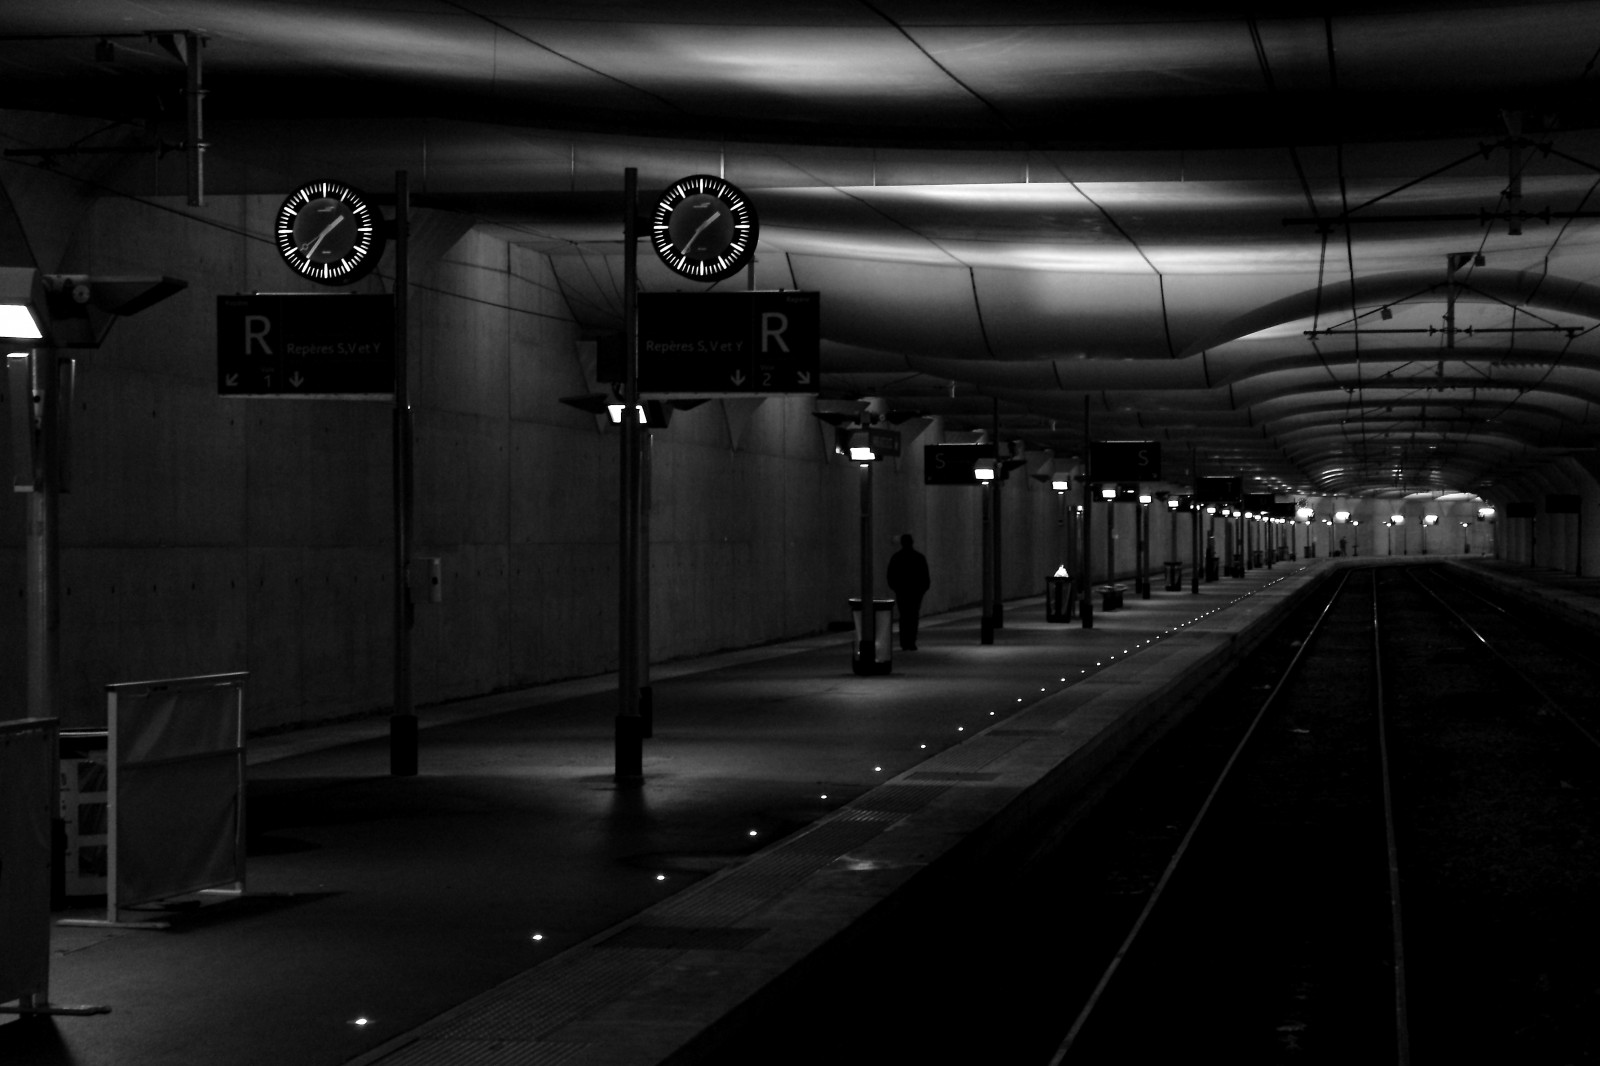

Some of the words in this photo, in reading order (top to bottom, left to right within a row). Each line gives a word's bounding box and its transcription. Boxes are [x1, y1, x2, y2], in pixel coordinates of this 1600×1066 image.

[244, 314, 274, 356] R
[761, 311, 791, 354] R
[286, 341, 335, 358] Repères
[358, 343, 371, 355] et
[371, 342, 381, 355] Y
[645, 339, 695, 354] Repères
[720, 340, 734, 352] et
[735, 339, 744, 352] Y
[263, 374, 272, 388] 1
[762, 372, 772, 387] 2
[935, 452, 946, 470] S
[1138, 448, 1150, 467] S
